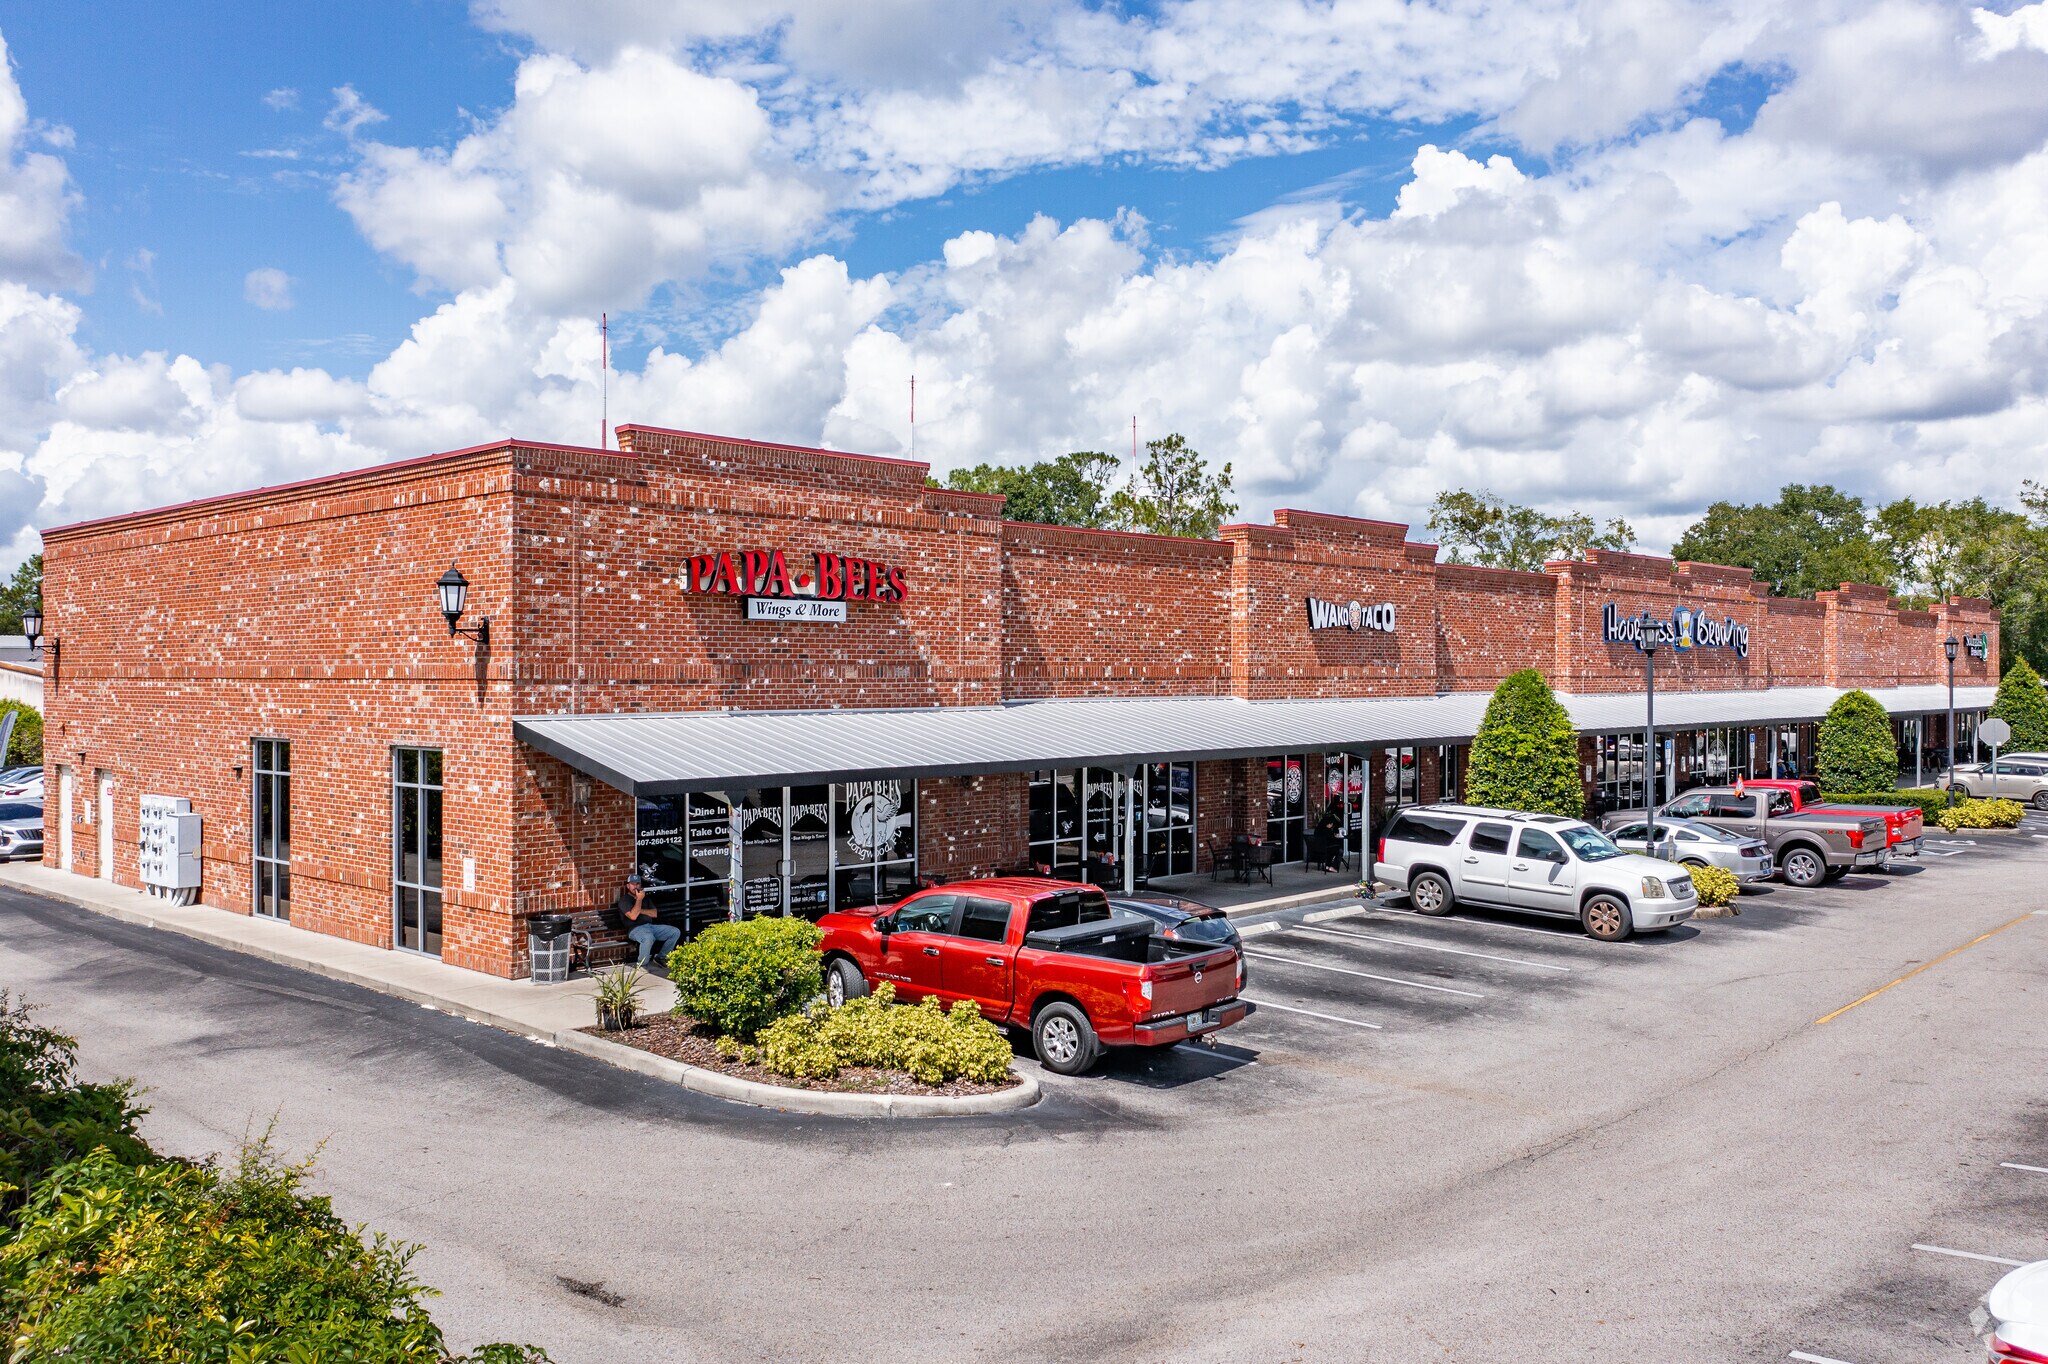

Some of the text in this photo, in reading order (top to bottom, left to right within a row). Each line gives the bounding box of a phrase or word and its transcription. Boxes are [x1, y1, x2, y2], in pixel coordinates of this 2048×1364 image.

[686, 550, 908, 603] PAPA BEES
[756, 601, 840, 618] Wings & More
[1306, 597, 1396, 633] WAKO TACO
[694, 806, 726, 816] Dine In
[640, 828, 678, 837] Call Ahead
[690, 828, 712, 837] Take
[692, 846, 730, 857] Catering
